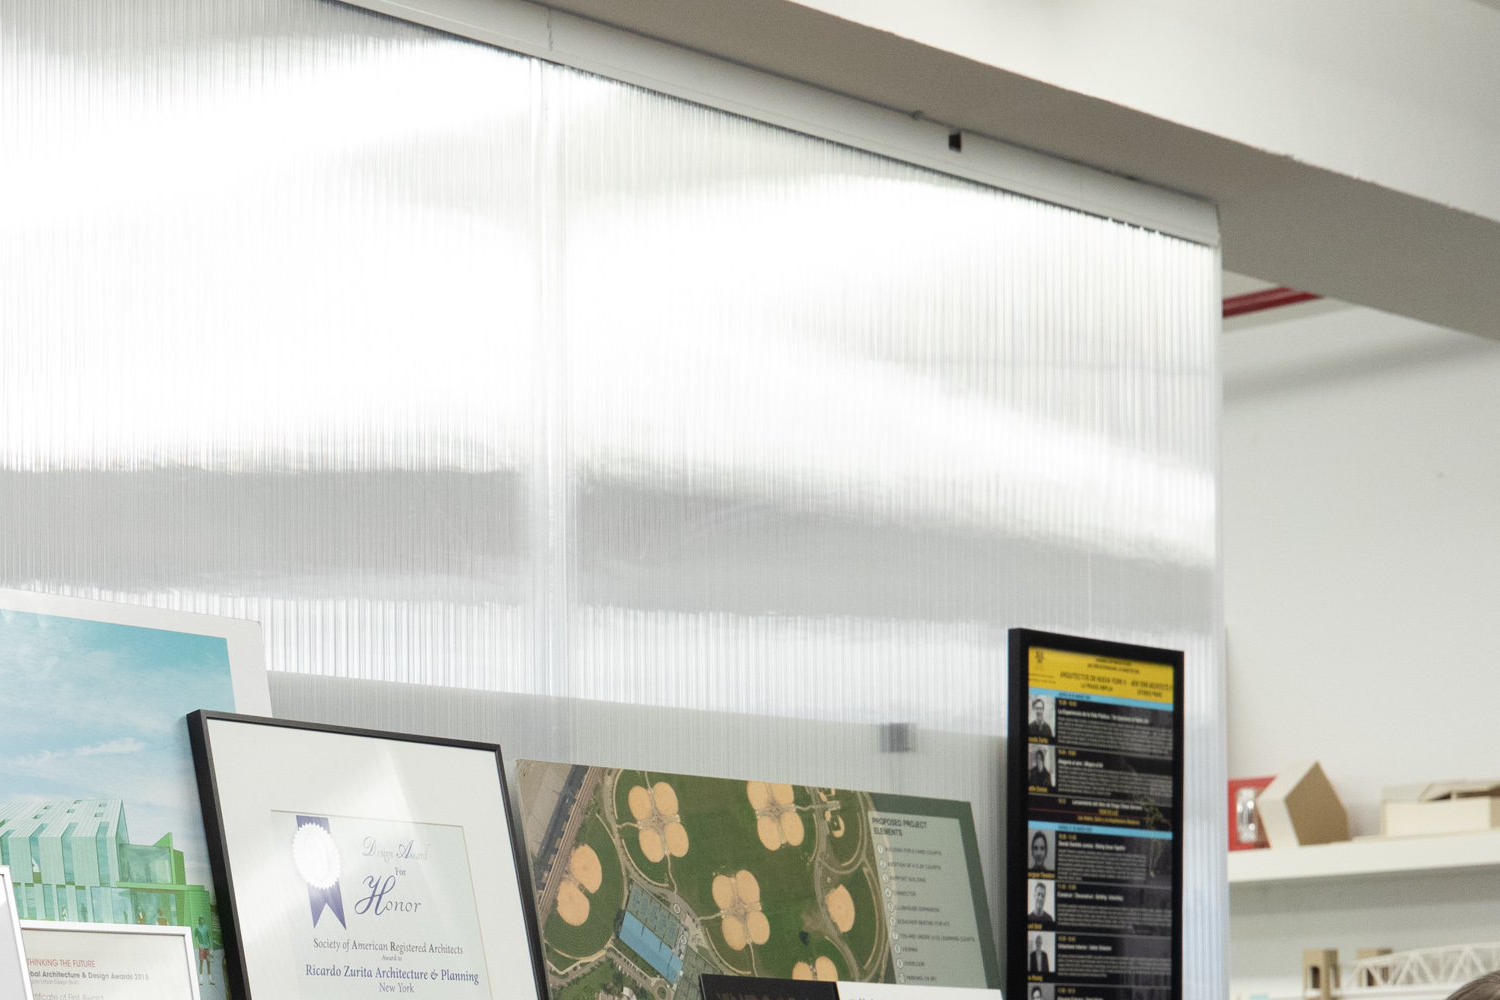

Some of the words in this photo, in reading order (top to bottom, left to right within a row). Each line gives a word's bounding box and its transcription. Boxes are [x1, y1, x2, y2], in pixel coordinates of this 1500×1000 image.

[872, 817, 902, 827] PROPOSED
[903, 820, 927, 829] PROJECT
[874, 827, 902, 836] ELEMENTS
[361, 836, 394, 863] Design
[396, 840, 430, 860] Award
[395, 867, 406, 876] For
[354, 875, 421, 916] Honor
[314, 938, 341, 951] Society
[342, 939, 350, 952] of
[351, 940, 388, 952] American
[390, 942, 427, 955] Registered
[428, 943, 463, 955] Architects
[59, 959, 71, 967] THE
[73, 959, 96, 968] FUTURE
[42, 971, 80, 979] Architecture
[88, 972, 109, 981] Design
[111, 973, 133, 981] Awards
[306, 964, 342, 977] Ricardo
[343, 966, 373, 978] Zurita
[375, 967, 428, 980] Architecture
[441, 969, 479, 985] Planning
[379, 982, 395, 993] New
[397, 983, 414, 993] York
[59, 993, 67, 1000] of
